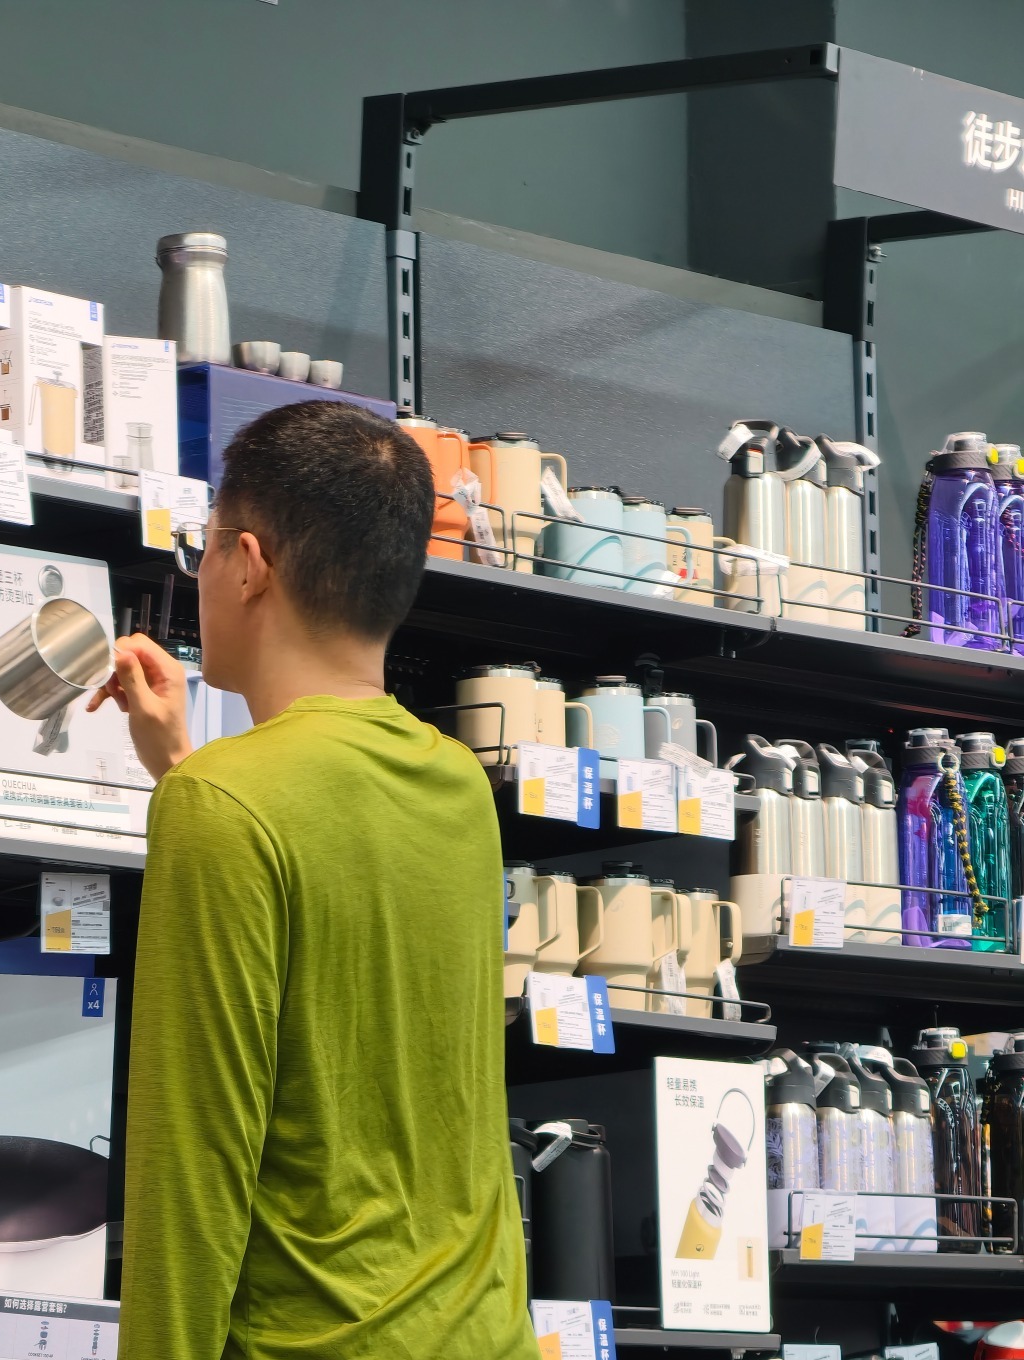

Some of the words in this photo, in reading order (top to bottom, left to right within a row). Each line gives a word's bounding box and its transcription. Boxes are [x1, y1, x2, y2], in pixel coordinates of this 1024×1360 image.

[962, 110, 1024, 171] 徒步
[1, 779, 37, 791] QUECHUA
[87, 1000, 100, 1010] x4
